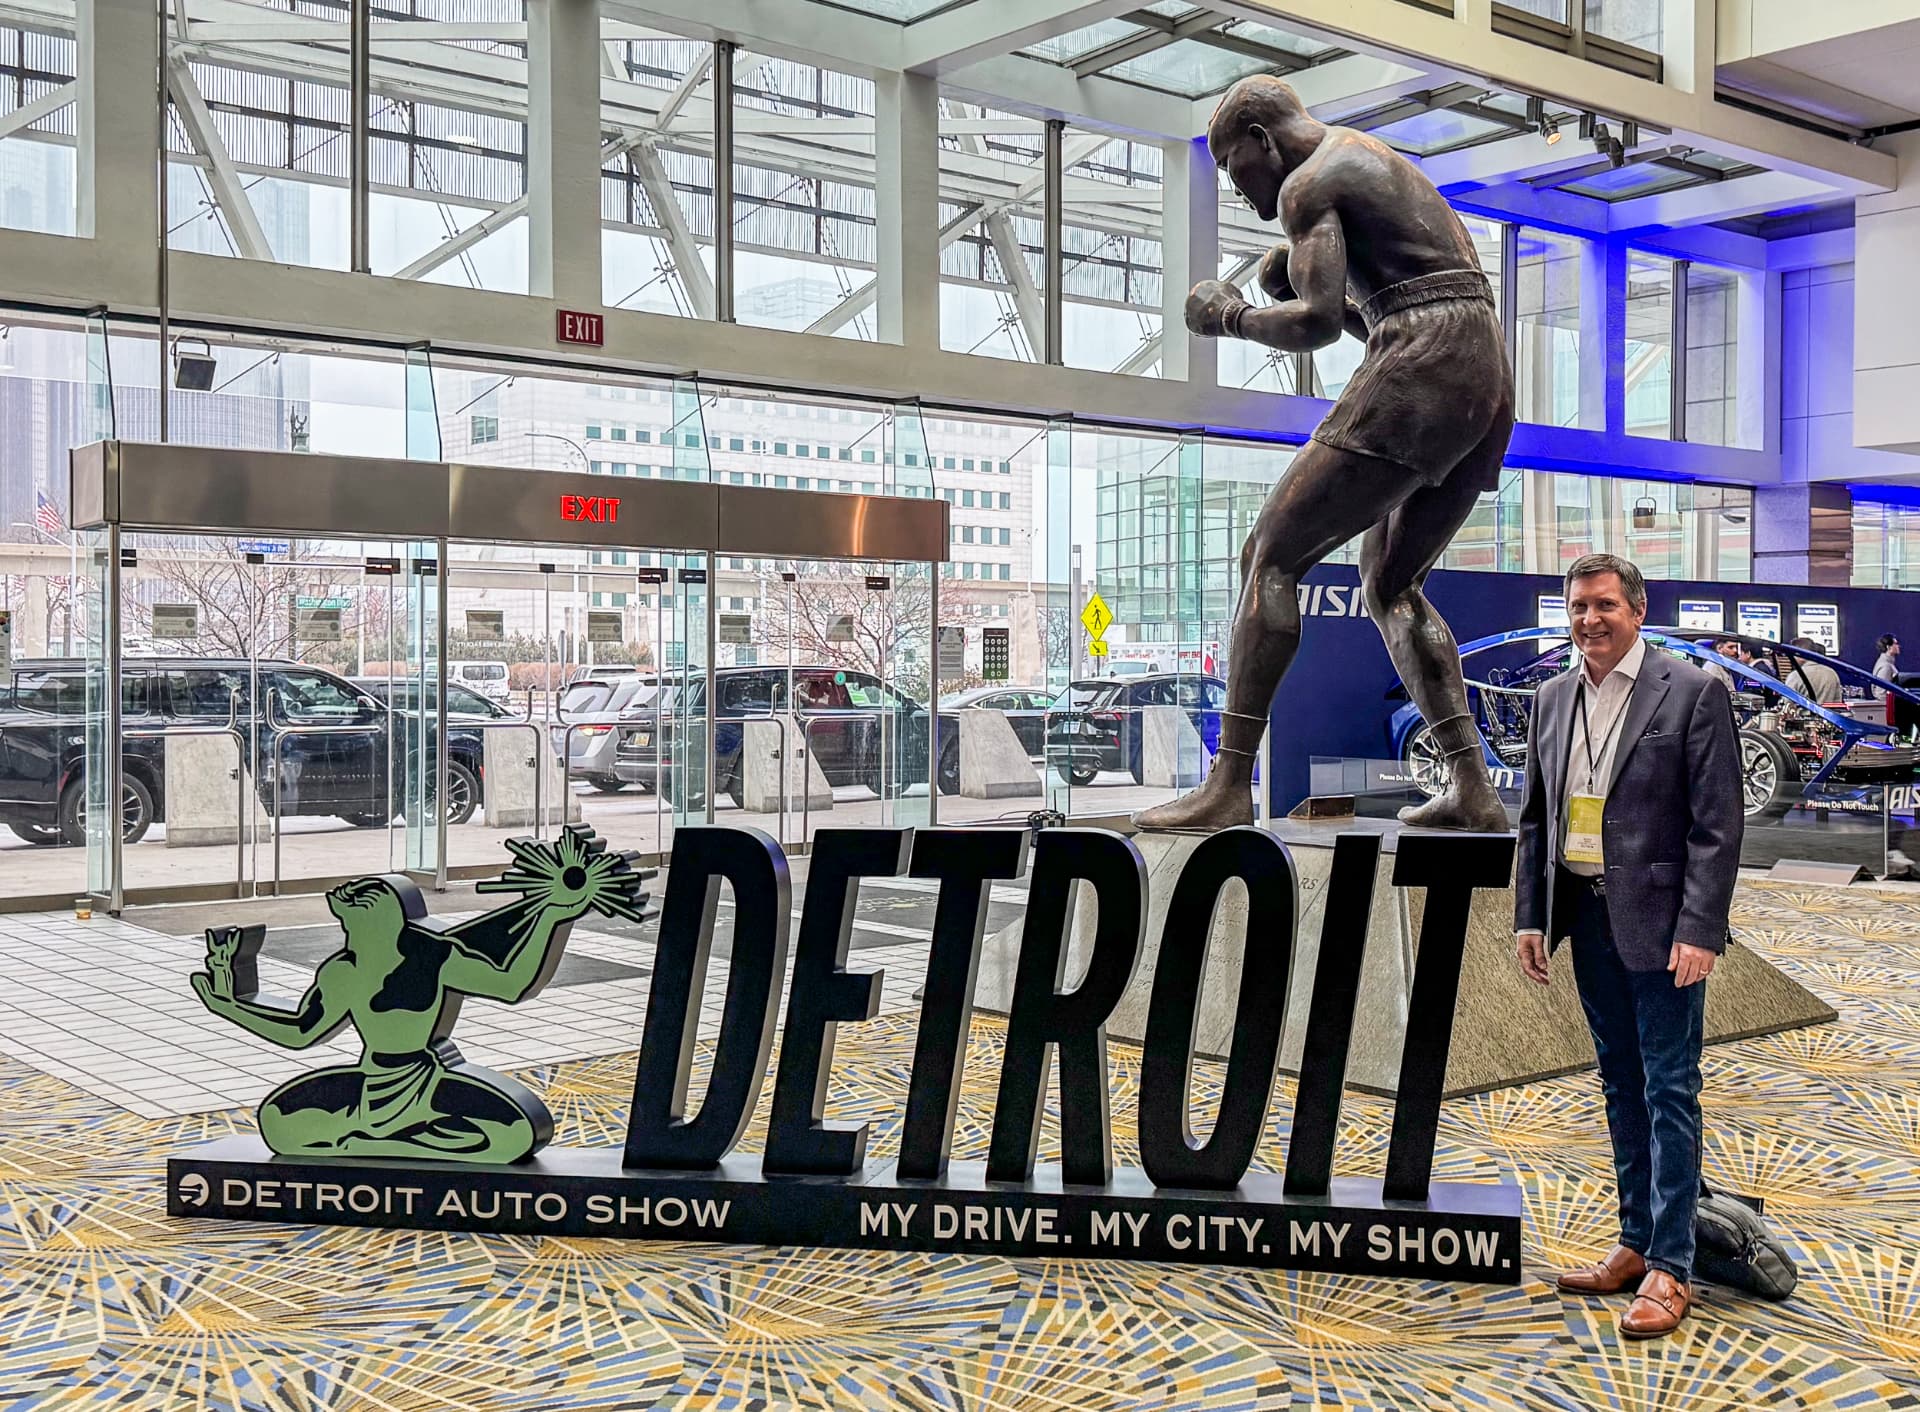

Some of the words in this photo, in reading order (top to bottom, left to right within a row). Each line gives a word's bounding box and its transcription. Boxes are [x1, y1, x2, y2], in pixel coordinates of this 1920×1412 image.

[565, 314, 598, 341] EXIT
[561, 495, 621, 523] EXIT
[1807, 800, 1830, 808] Please
[1831, 801, 1841, 809] Do
[1842, 801, 1857, 810] Not
[1857, 802, 1879, 811] Touch
[622, 826, 1515, 1201] DETROIT
[223, 1179, 423, 1215] DETROIT
[436, 1189, 567, 1222] AUTO
[585, 1195, 731, 1228] SHOW
[860, 1202, 918, 1237] MY
[934, 1204, 1072, 1244] DRIVE.
[1091, 1210, 1150, 1247] MY
[1166, 1214, 1270, 1254] CITY.
[1290, 1220, 1352, 1258] MY
[1367, 1224, 1510, 1268] SHOW.
